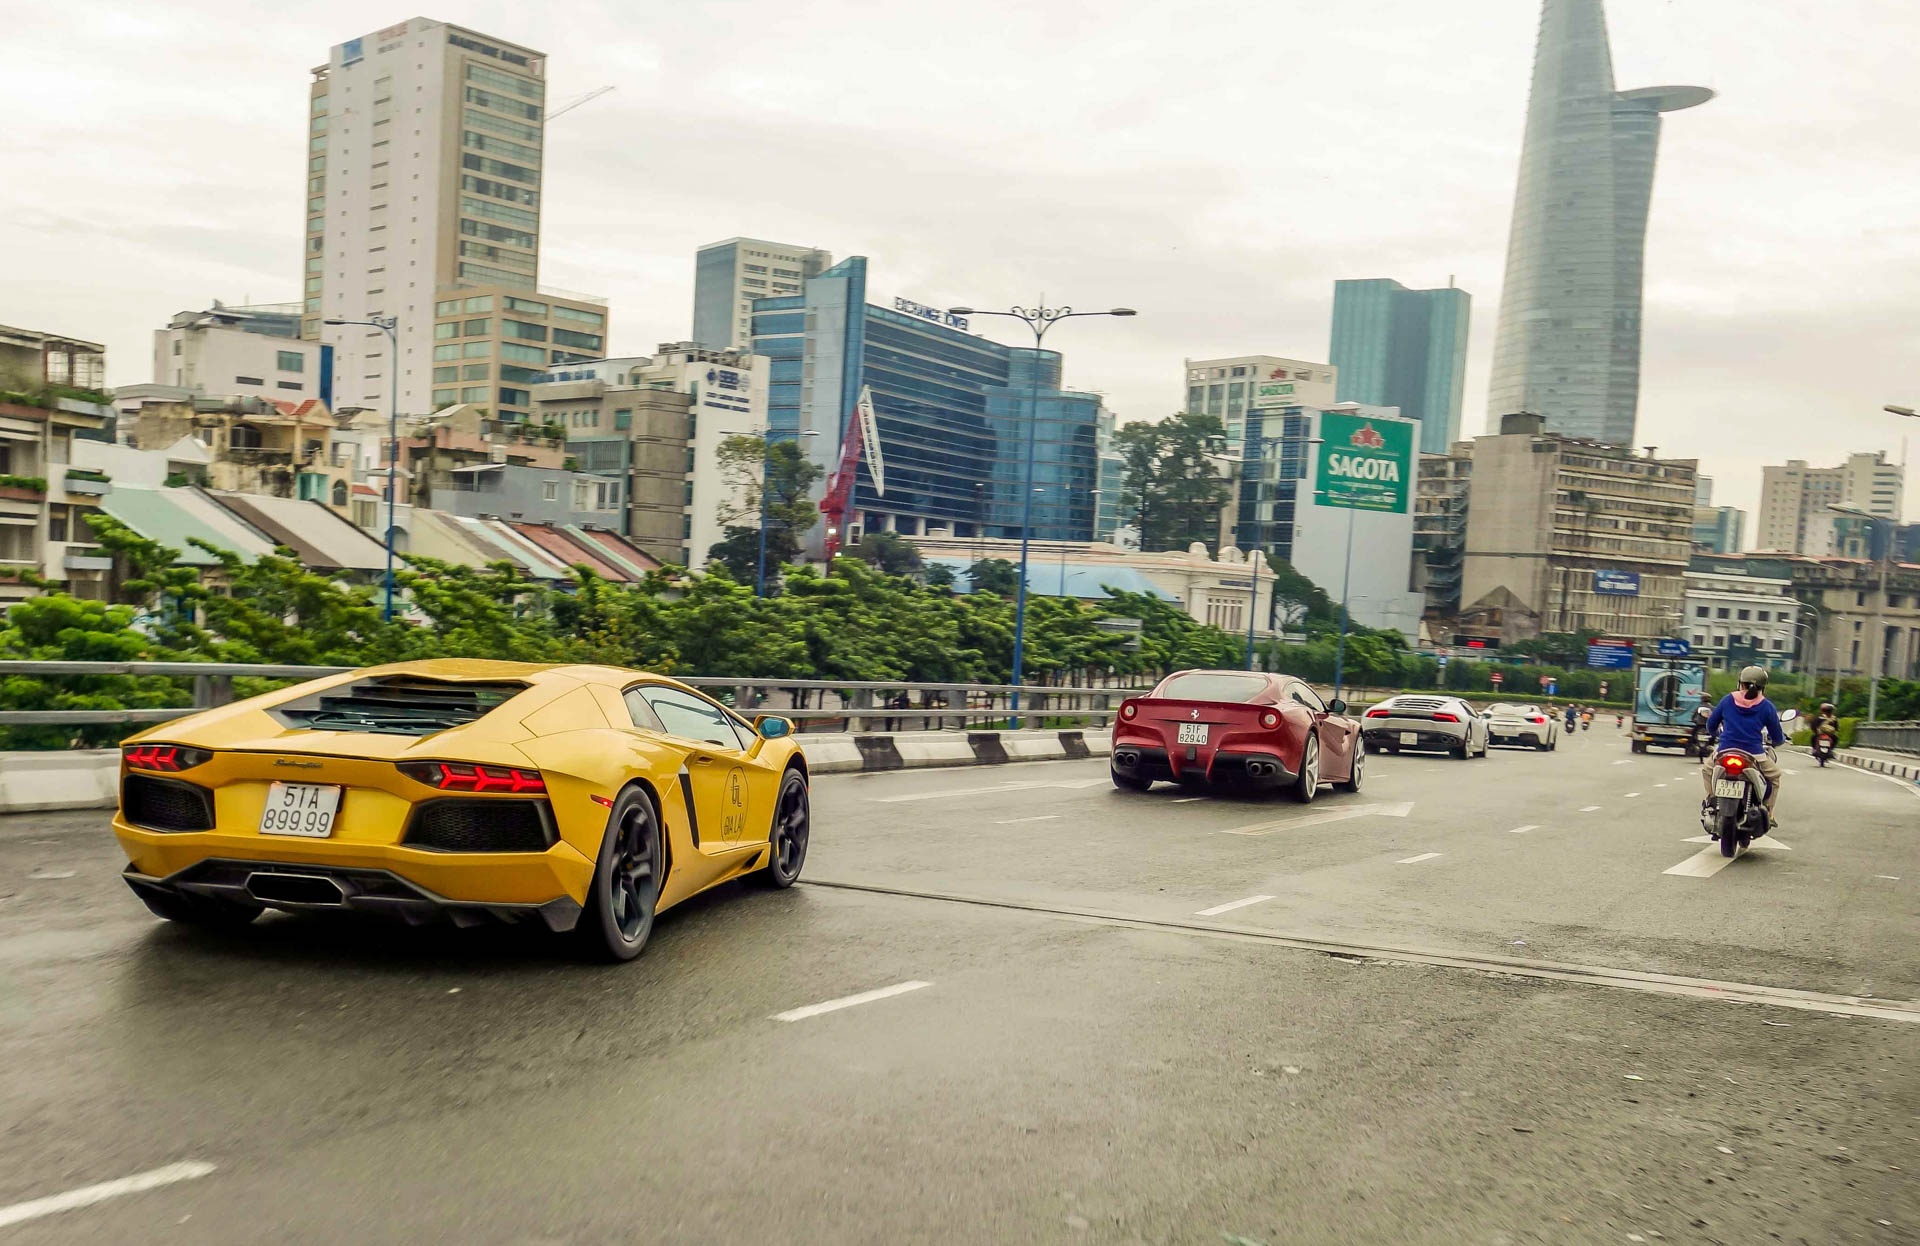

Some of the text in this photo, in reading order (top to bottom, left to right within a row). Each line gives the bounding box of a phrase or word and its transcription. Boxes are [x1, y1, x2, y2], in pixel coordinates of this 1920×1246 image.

[1328, 453, 1399, 482] SAGOTA
[1186, 724, 1201, 734] 51F
[283, 786, 319, 809] 51A
[263, 808, 330, 833] 899.99
